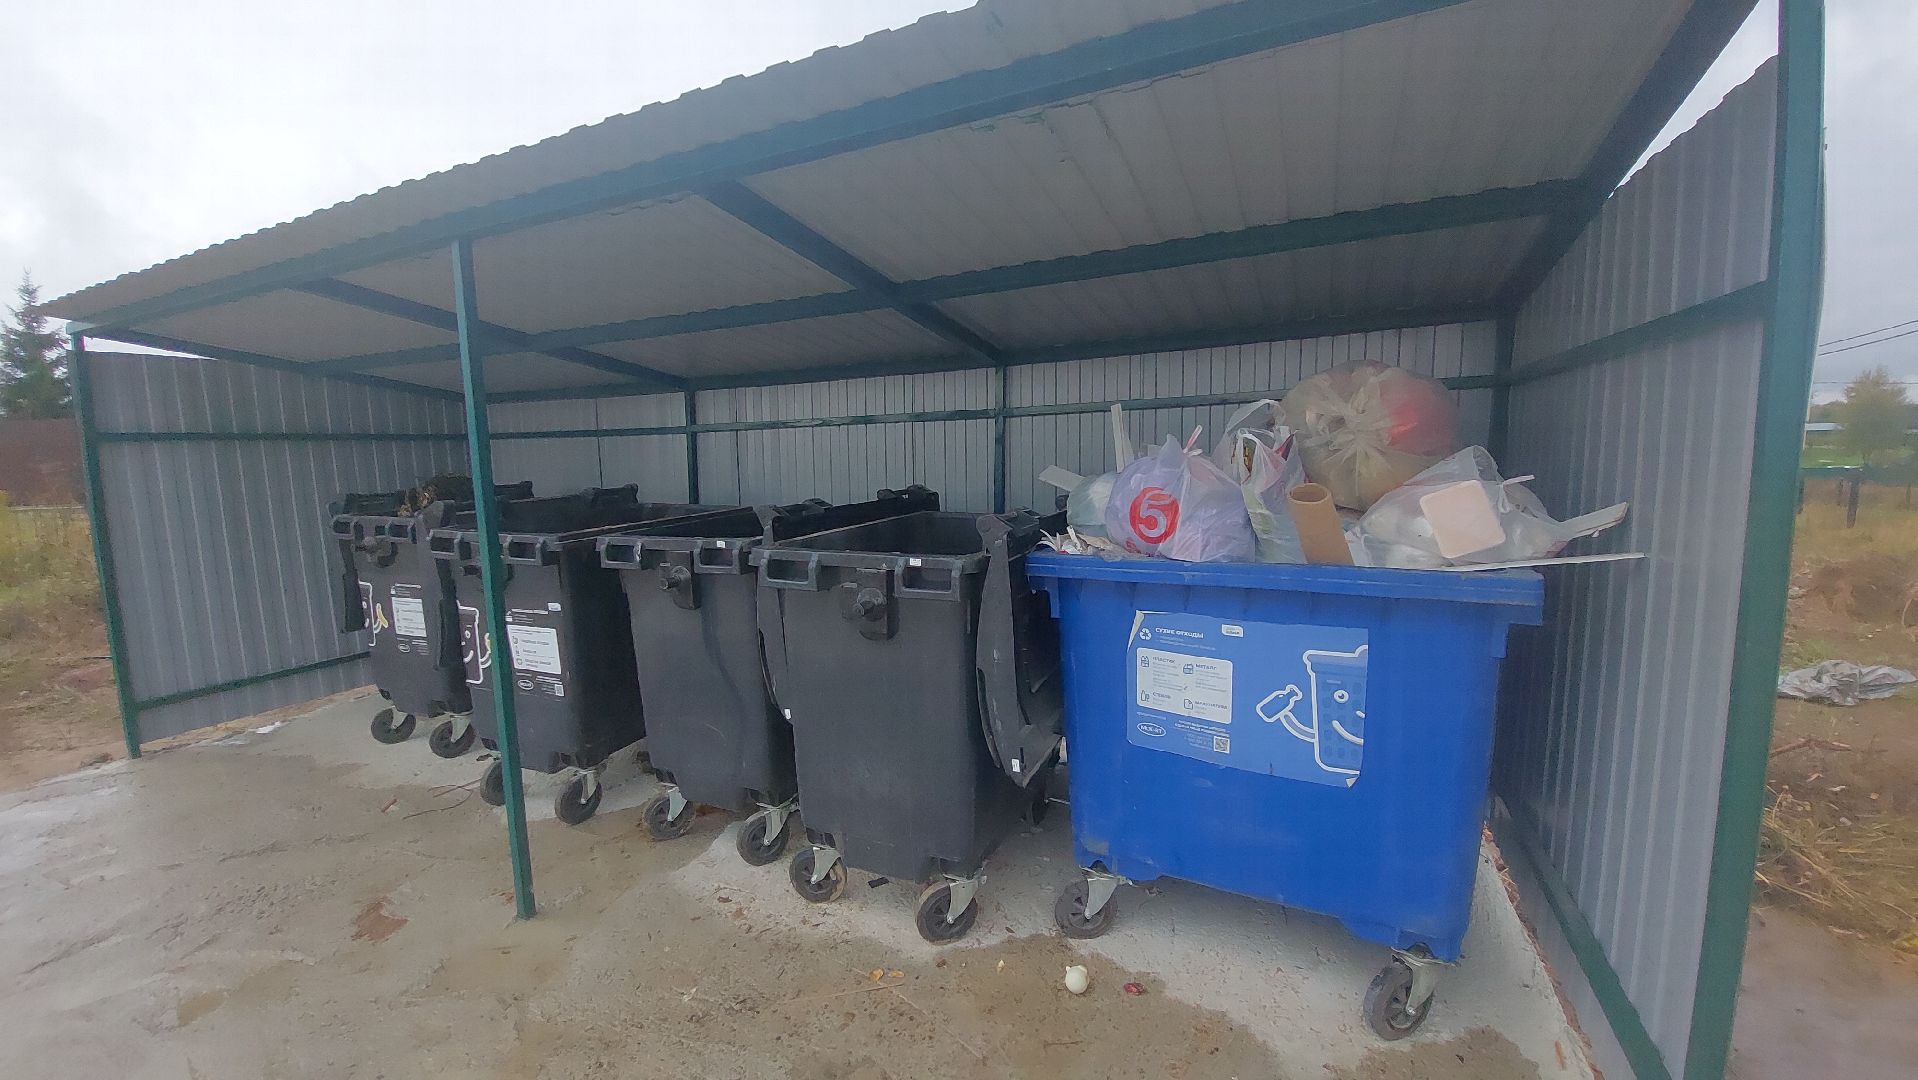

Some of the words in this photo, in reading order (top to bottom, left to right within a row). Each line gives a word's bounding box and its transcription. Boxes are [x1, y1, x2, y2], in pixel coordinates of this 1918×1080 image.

[1137, 487, 1175, 539] 5
[1155, 627, 1175, 635] СУХИЕ
[1176, 630, 1204, 639] ОТХОДЫ
